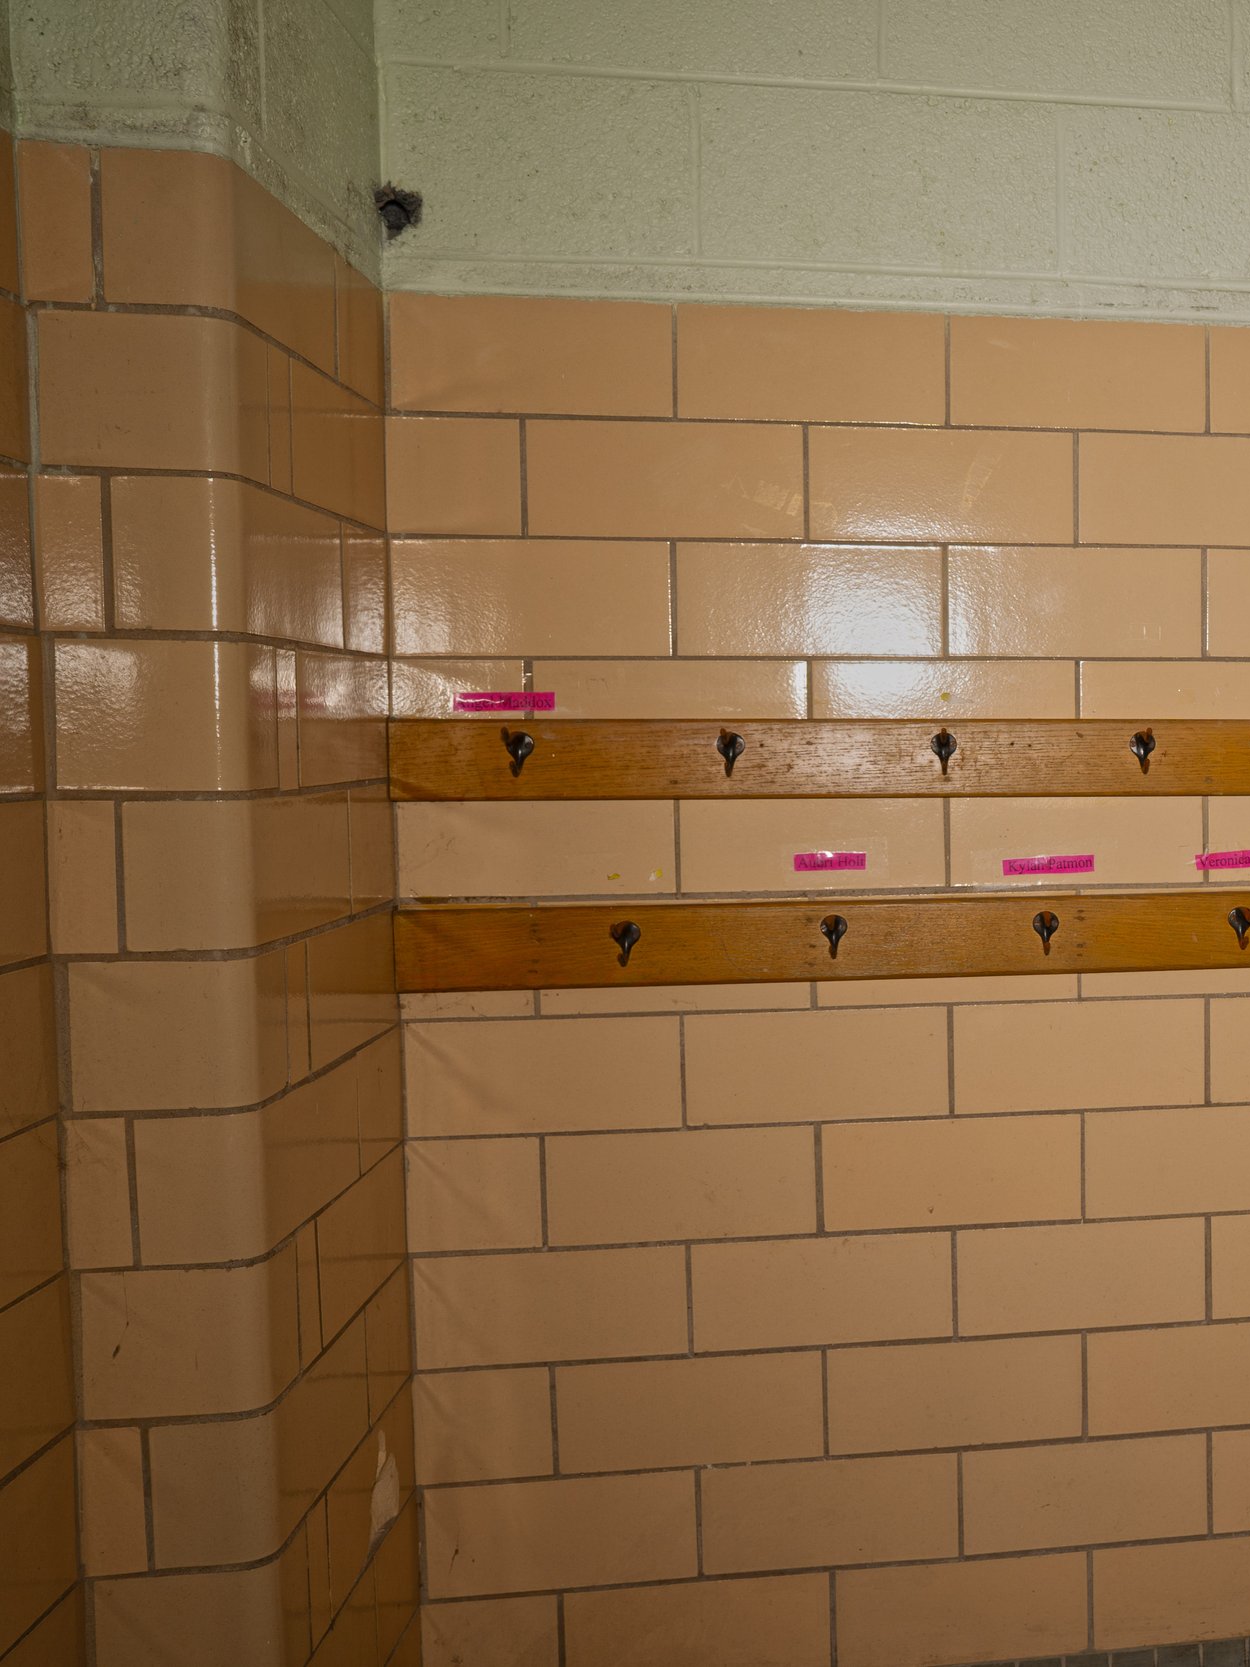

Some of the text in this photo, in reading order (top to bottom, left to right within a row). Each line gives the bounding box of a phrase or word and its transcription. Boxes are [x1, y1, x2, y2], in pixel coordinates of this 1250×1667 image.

[500, 695, 552, 709] Maddox
[1047, 858, 1093, 870] Patmon
[1199, 853, 1250, 868] Veronica
